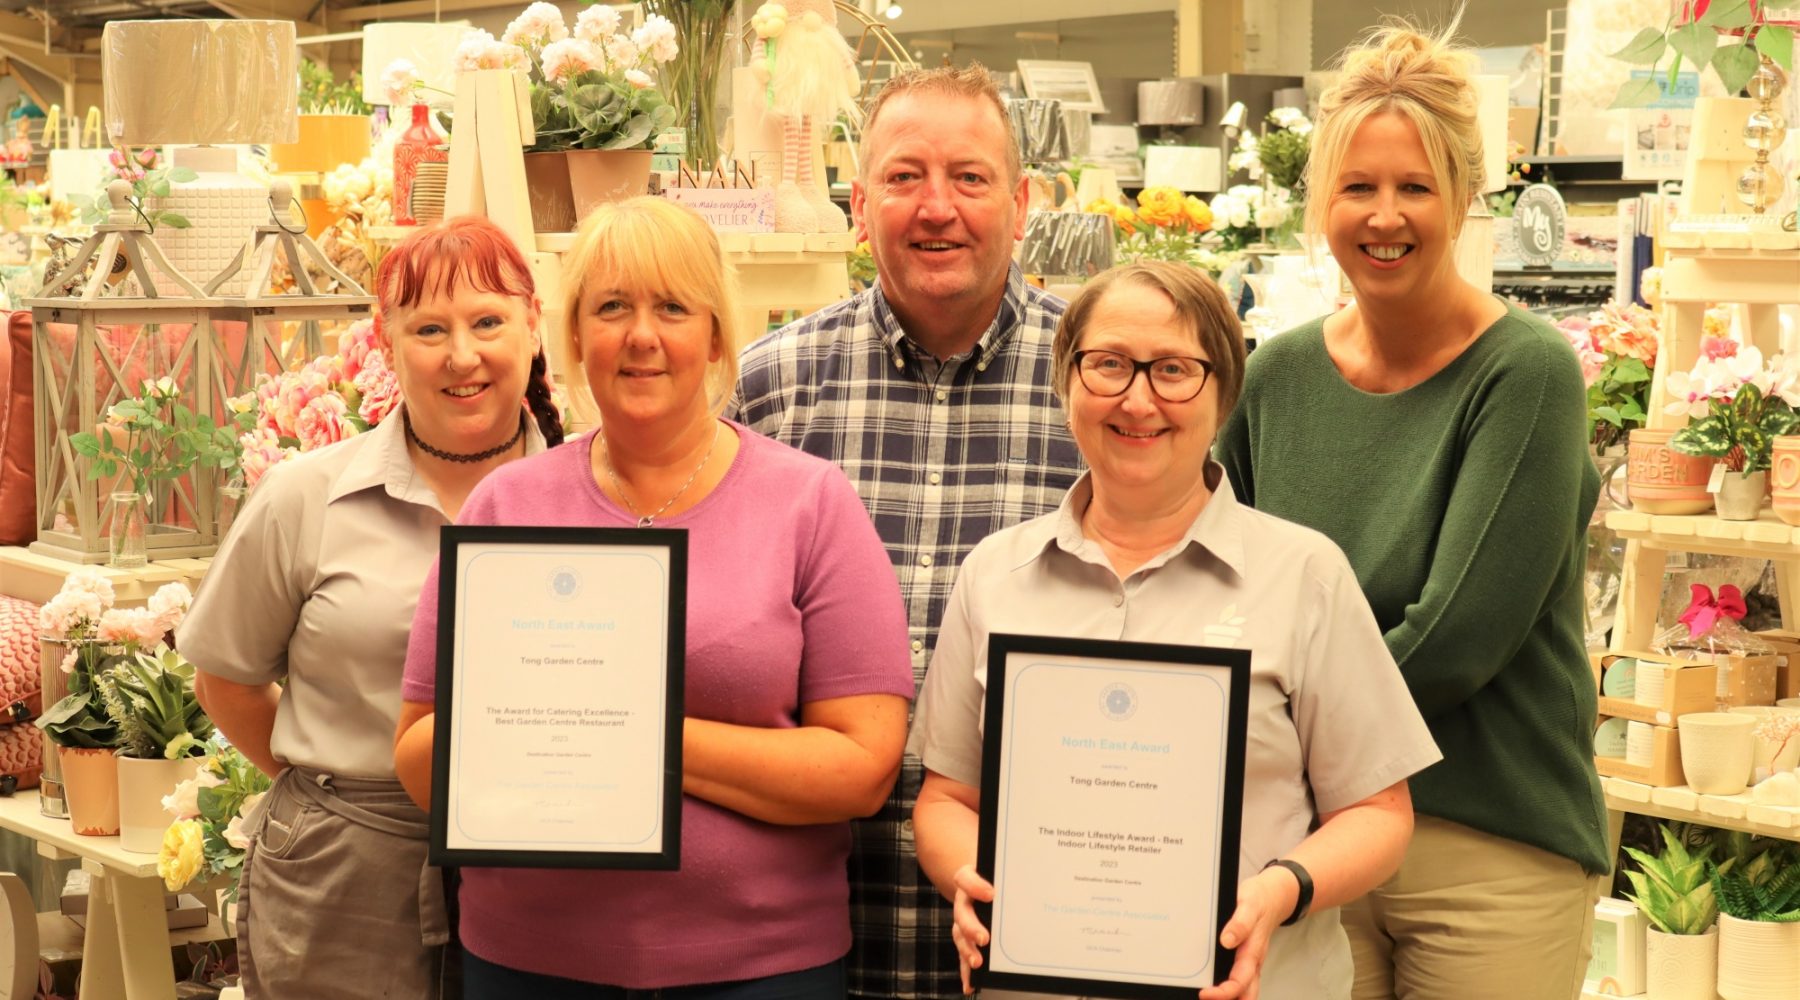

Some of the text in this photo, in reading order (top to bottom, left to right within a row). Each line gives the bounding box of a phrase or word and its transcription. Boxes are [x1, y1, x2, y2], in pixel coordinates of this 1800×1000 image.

[678, 158, 757, 189] NAN
[698, 200, 718, 209] make
[719, 199, 758, 214] everything
[704, 214, 748, 226] VELIER
[1630, 447, 1671, 464] UM'S
[511, 617, 616, 632] North East Award
[520, 656, 605, 667] Tong Garden Centre
[486, 706, 502, 715] The
[503, 707, 531, 716] Award
[532, 707, 544, 716] for
[546, 708, 582, 718] Catering
[584, 708, 630, 718] Excellence
[495, 717, 625, 728] Best Garden Centre Restaurant
[1061, 735, 1171, 754] North East Award
[1070, 775, 1159, 790] Tong Garden Centre
[1038, 826, 1055, 836] The
[1056, 828, 1086, 838] Indoor
[1087, 830, 1125, 842] Lifestyle
[1127, 833, 1156, 843] Award
[1162, 836, 1184, 846] Best
[1057, 839, 1163, 855] Indoor Lifestyle Retailer
[1099, 859, 1119, 869] 2023
